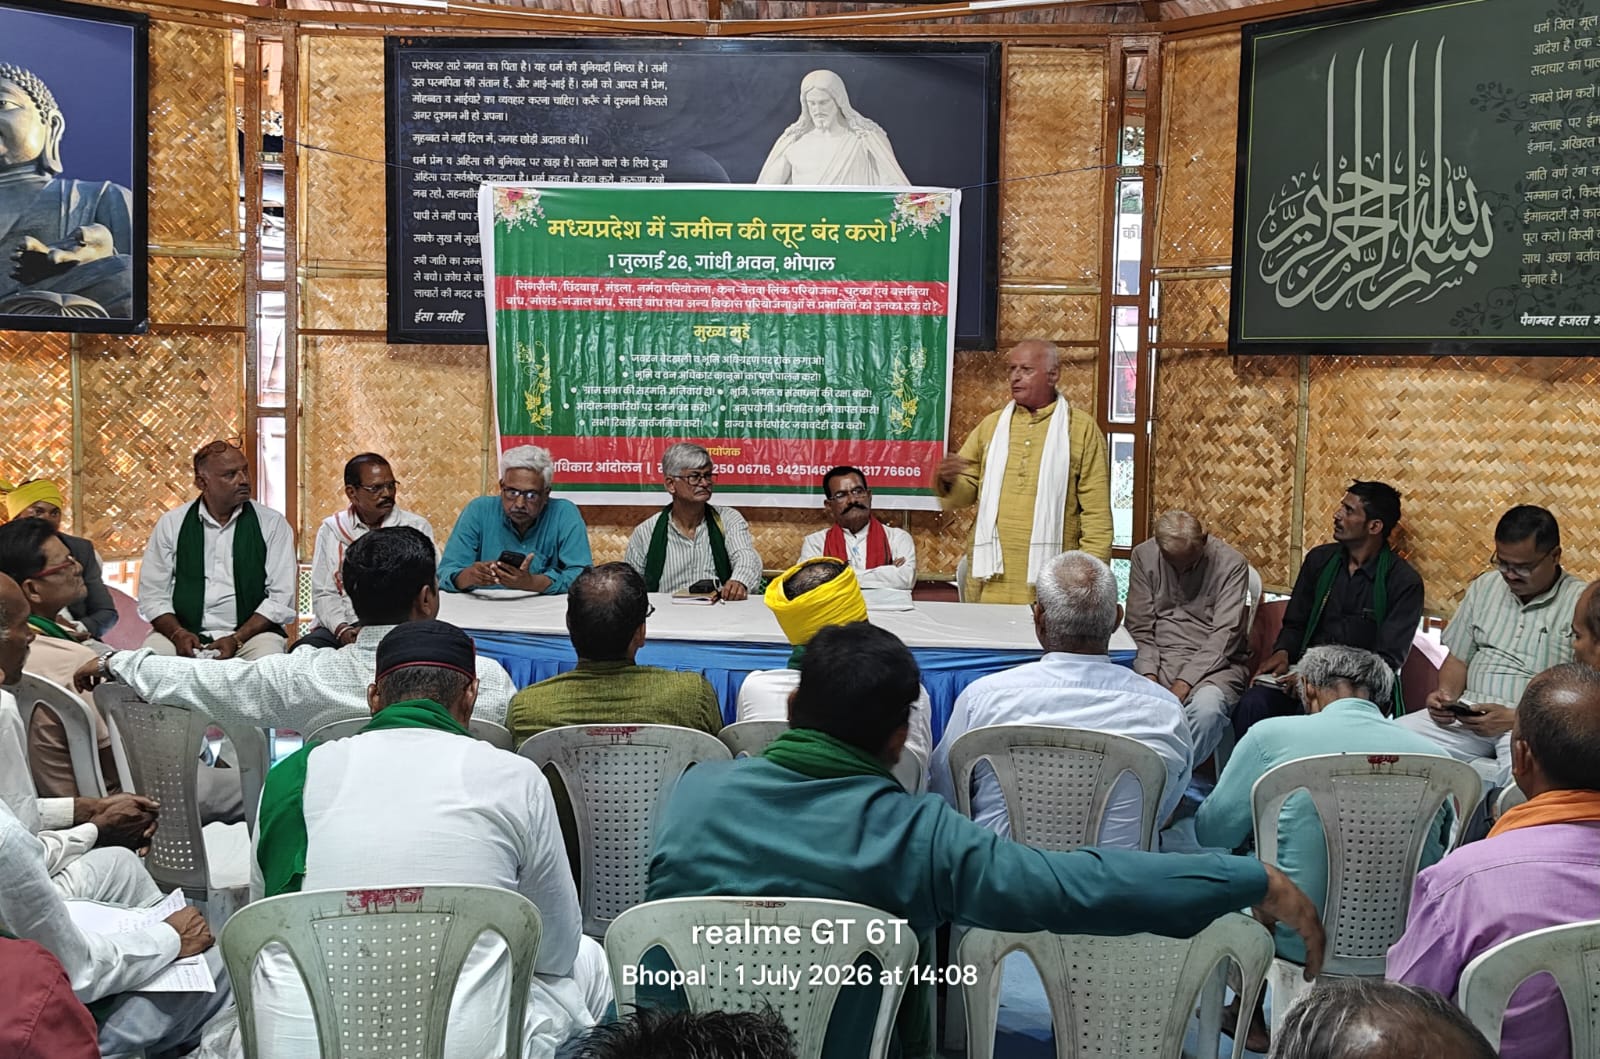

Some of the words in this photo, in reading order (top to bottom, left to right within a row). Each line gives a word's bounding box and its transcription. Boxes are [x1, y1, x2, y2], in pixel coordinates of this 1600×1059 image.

[447, 60, 460, 70] सारे
[464, 62, 484, 71] जगत
[487, 62, 498, 71] का
[566, 61, 577, 72] की
[1568, 60, 1581, 70] का
[547, 215, 642, 240] मध्यप्रदेश
[647, 216, 666, 239] में
[670, 216, 732, 240] जमीन
[738, 217, 766, 240] की
[772, 222, 806, 250] लूट
[811, 218, 840, 243] बंद
[608, 254, 614, 268] 1
[618, 250, 665, 272] जुलाई
[668, 255, 692, 272] 26,
[696, 251, 732, 271] गांधी
[784, 252, 836, 271] भोपाल
[414, 309, 434, 323] ईसा
[437, 310, 466, 323] मसीह
[596, 460, 642, 473] आंदोलन
[884, 466, 920, 477] 76606
